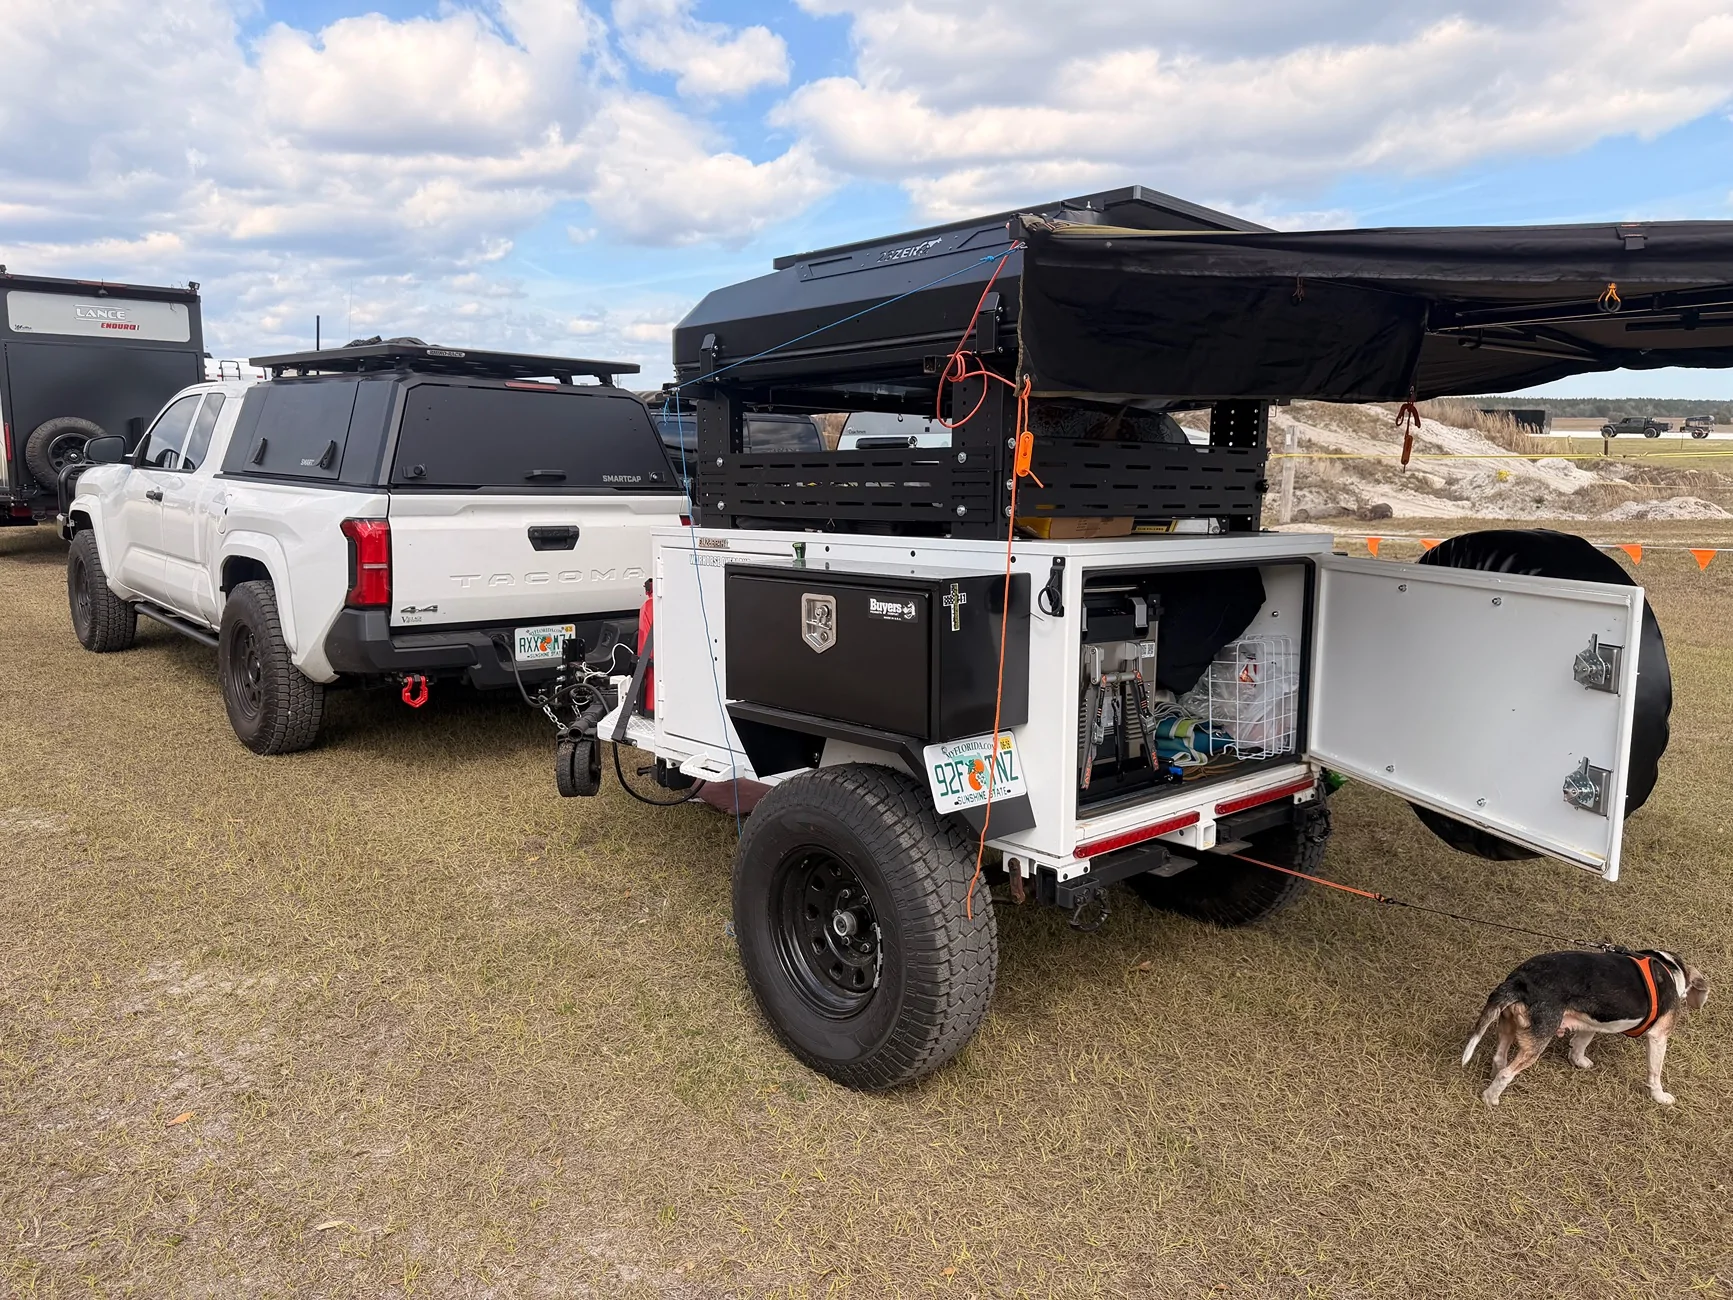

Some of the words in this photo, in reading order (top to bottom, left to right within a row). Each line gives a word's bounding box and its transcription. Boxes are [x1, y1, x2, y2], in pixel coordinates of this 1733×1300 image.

[76, 308, 126, 320] LANCE
[602, 474, 642, 483] SMARTCAP
[449, 567, 646, 588] TACOMA
[870, 598, 902, 614] Buyers
[519, 637, 540, 654] RXX
[934, 760, 964, 797] 92F
[984, 750, 1019, 785] TNZ
[957, 790, 987, 805] SUNSHINE
[989, 787, 1007, 798] STATE
